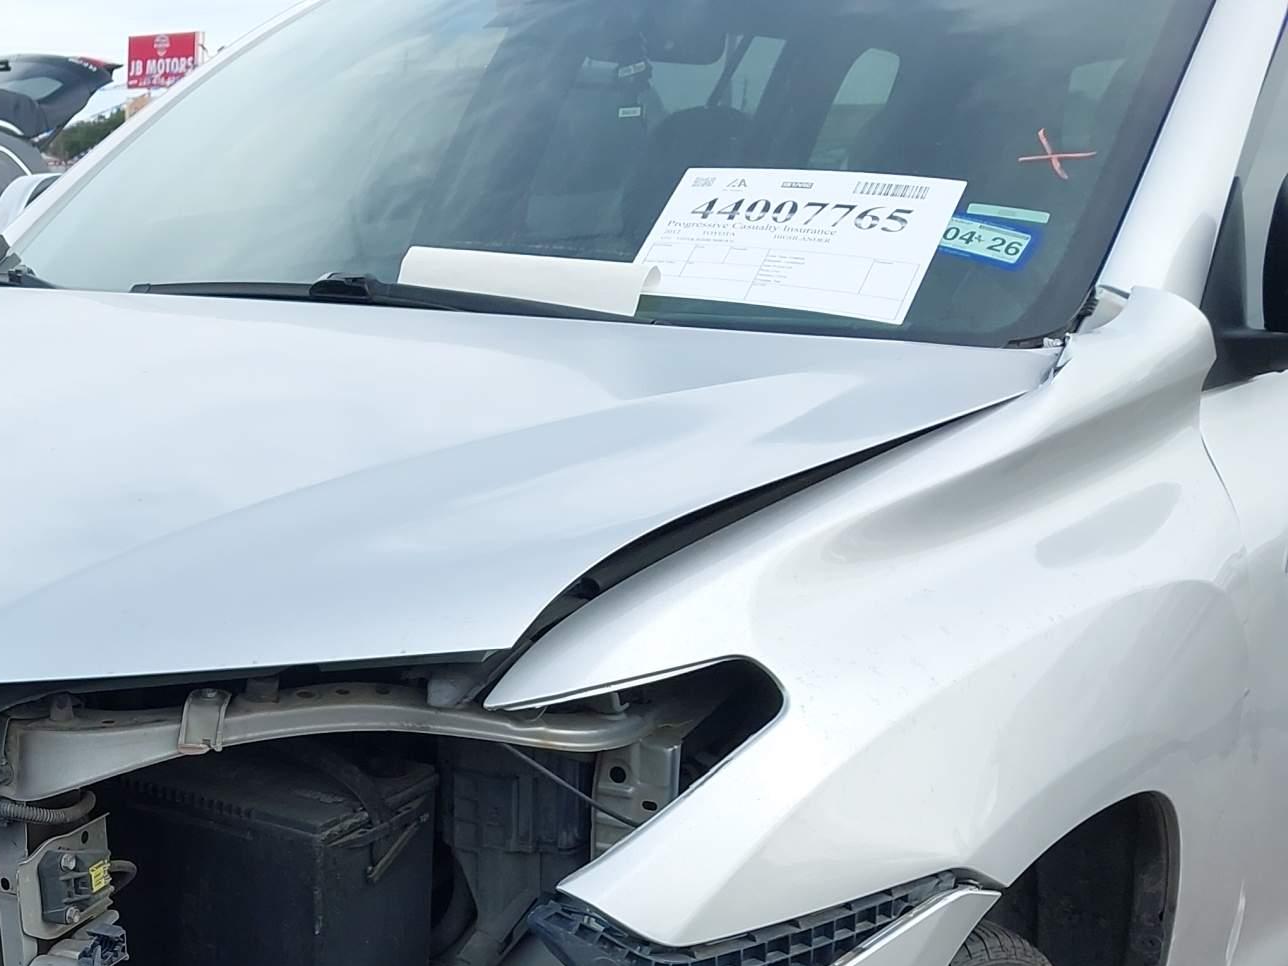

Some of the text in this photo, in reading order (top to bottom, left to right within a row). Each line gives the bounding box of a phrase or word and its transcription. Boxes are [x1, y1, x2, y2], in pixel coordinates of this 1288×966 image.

[129, 57, 194, 76] JB MOTORS
[691, 198, 914, 233] 44007765
[667, 219, 837, 237] Progressive Casualty Insurance
[942, 226, 976, 245] 04
[986, 237, 1023, 256] 26
